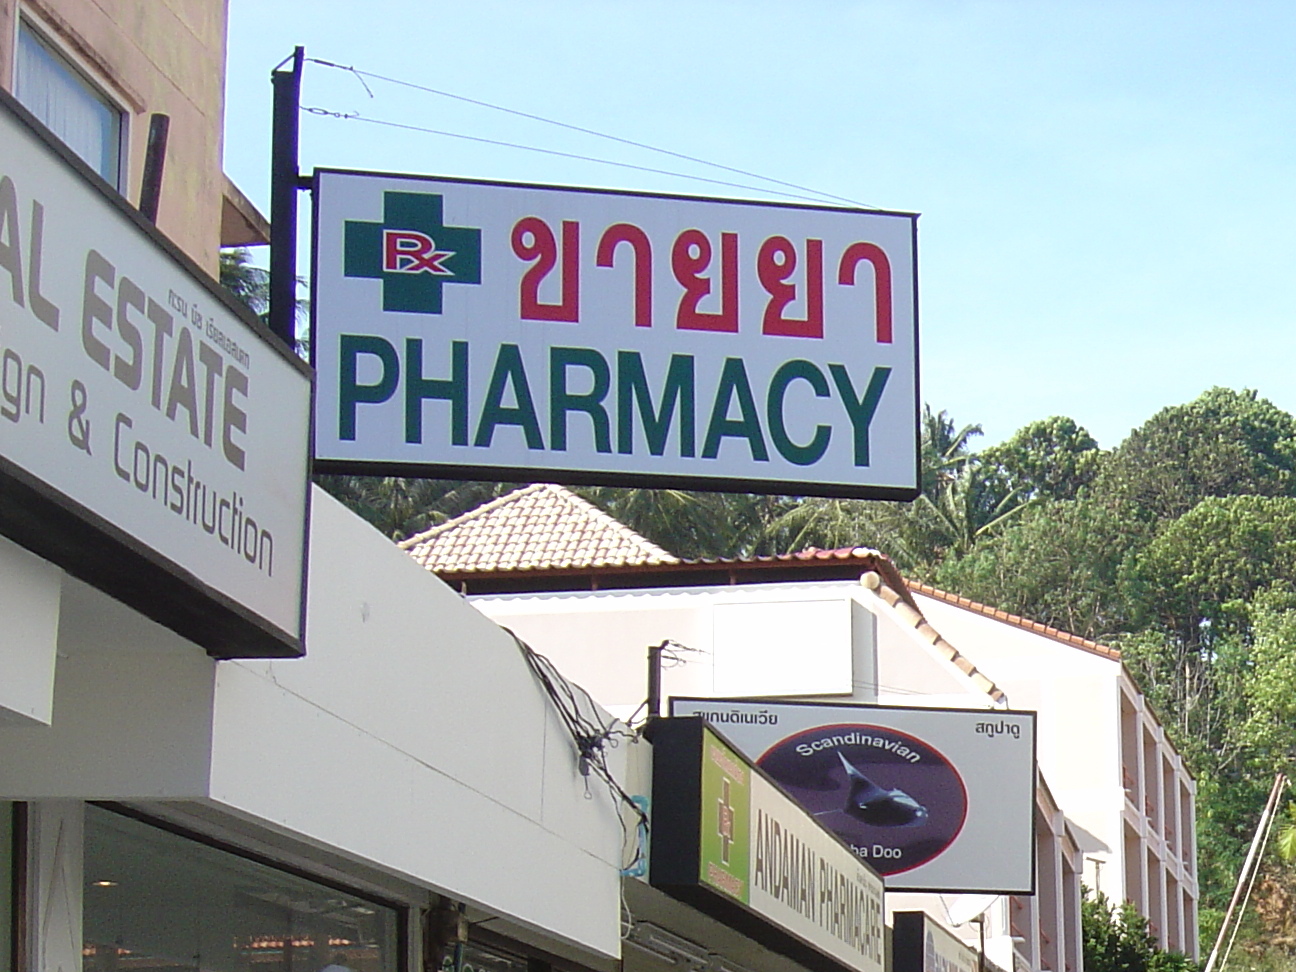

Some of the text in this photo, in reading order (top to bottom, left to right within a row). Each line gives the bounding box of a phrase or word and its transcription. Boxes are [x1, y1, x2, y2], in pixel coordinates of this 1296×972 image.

[510, 215, 894, 345] ขายยา
[82, 249, 249, 472] ESTATE
[338, 332, 893, 468] PHARMACY
[68, 379, 93, 457] &
[114, 411, 274, 577] Construction
[795, 731, 921, 764] Scandinavian
[754, 807, 816, 924] ANDAMAN
[872, 844, 902, 860] Doo
